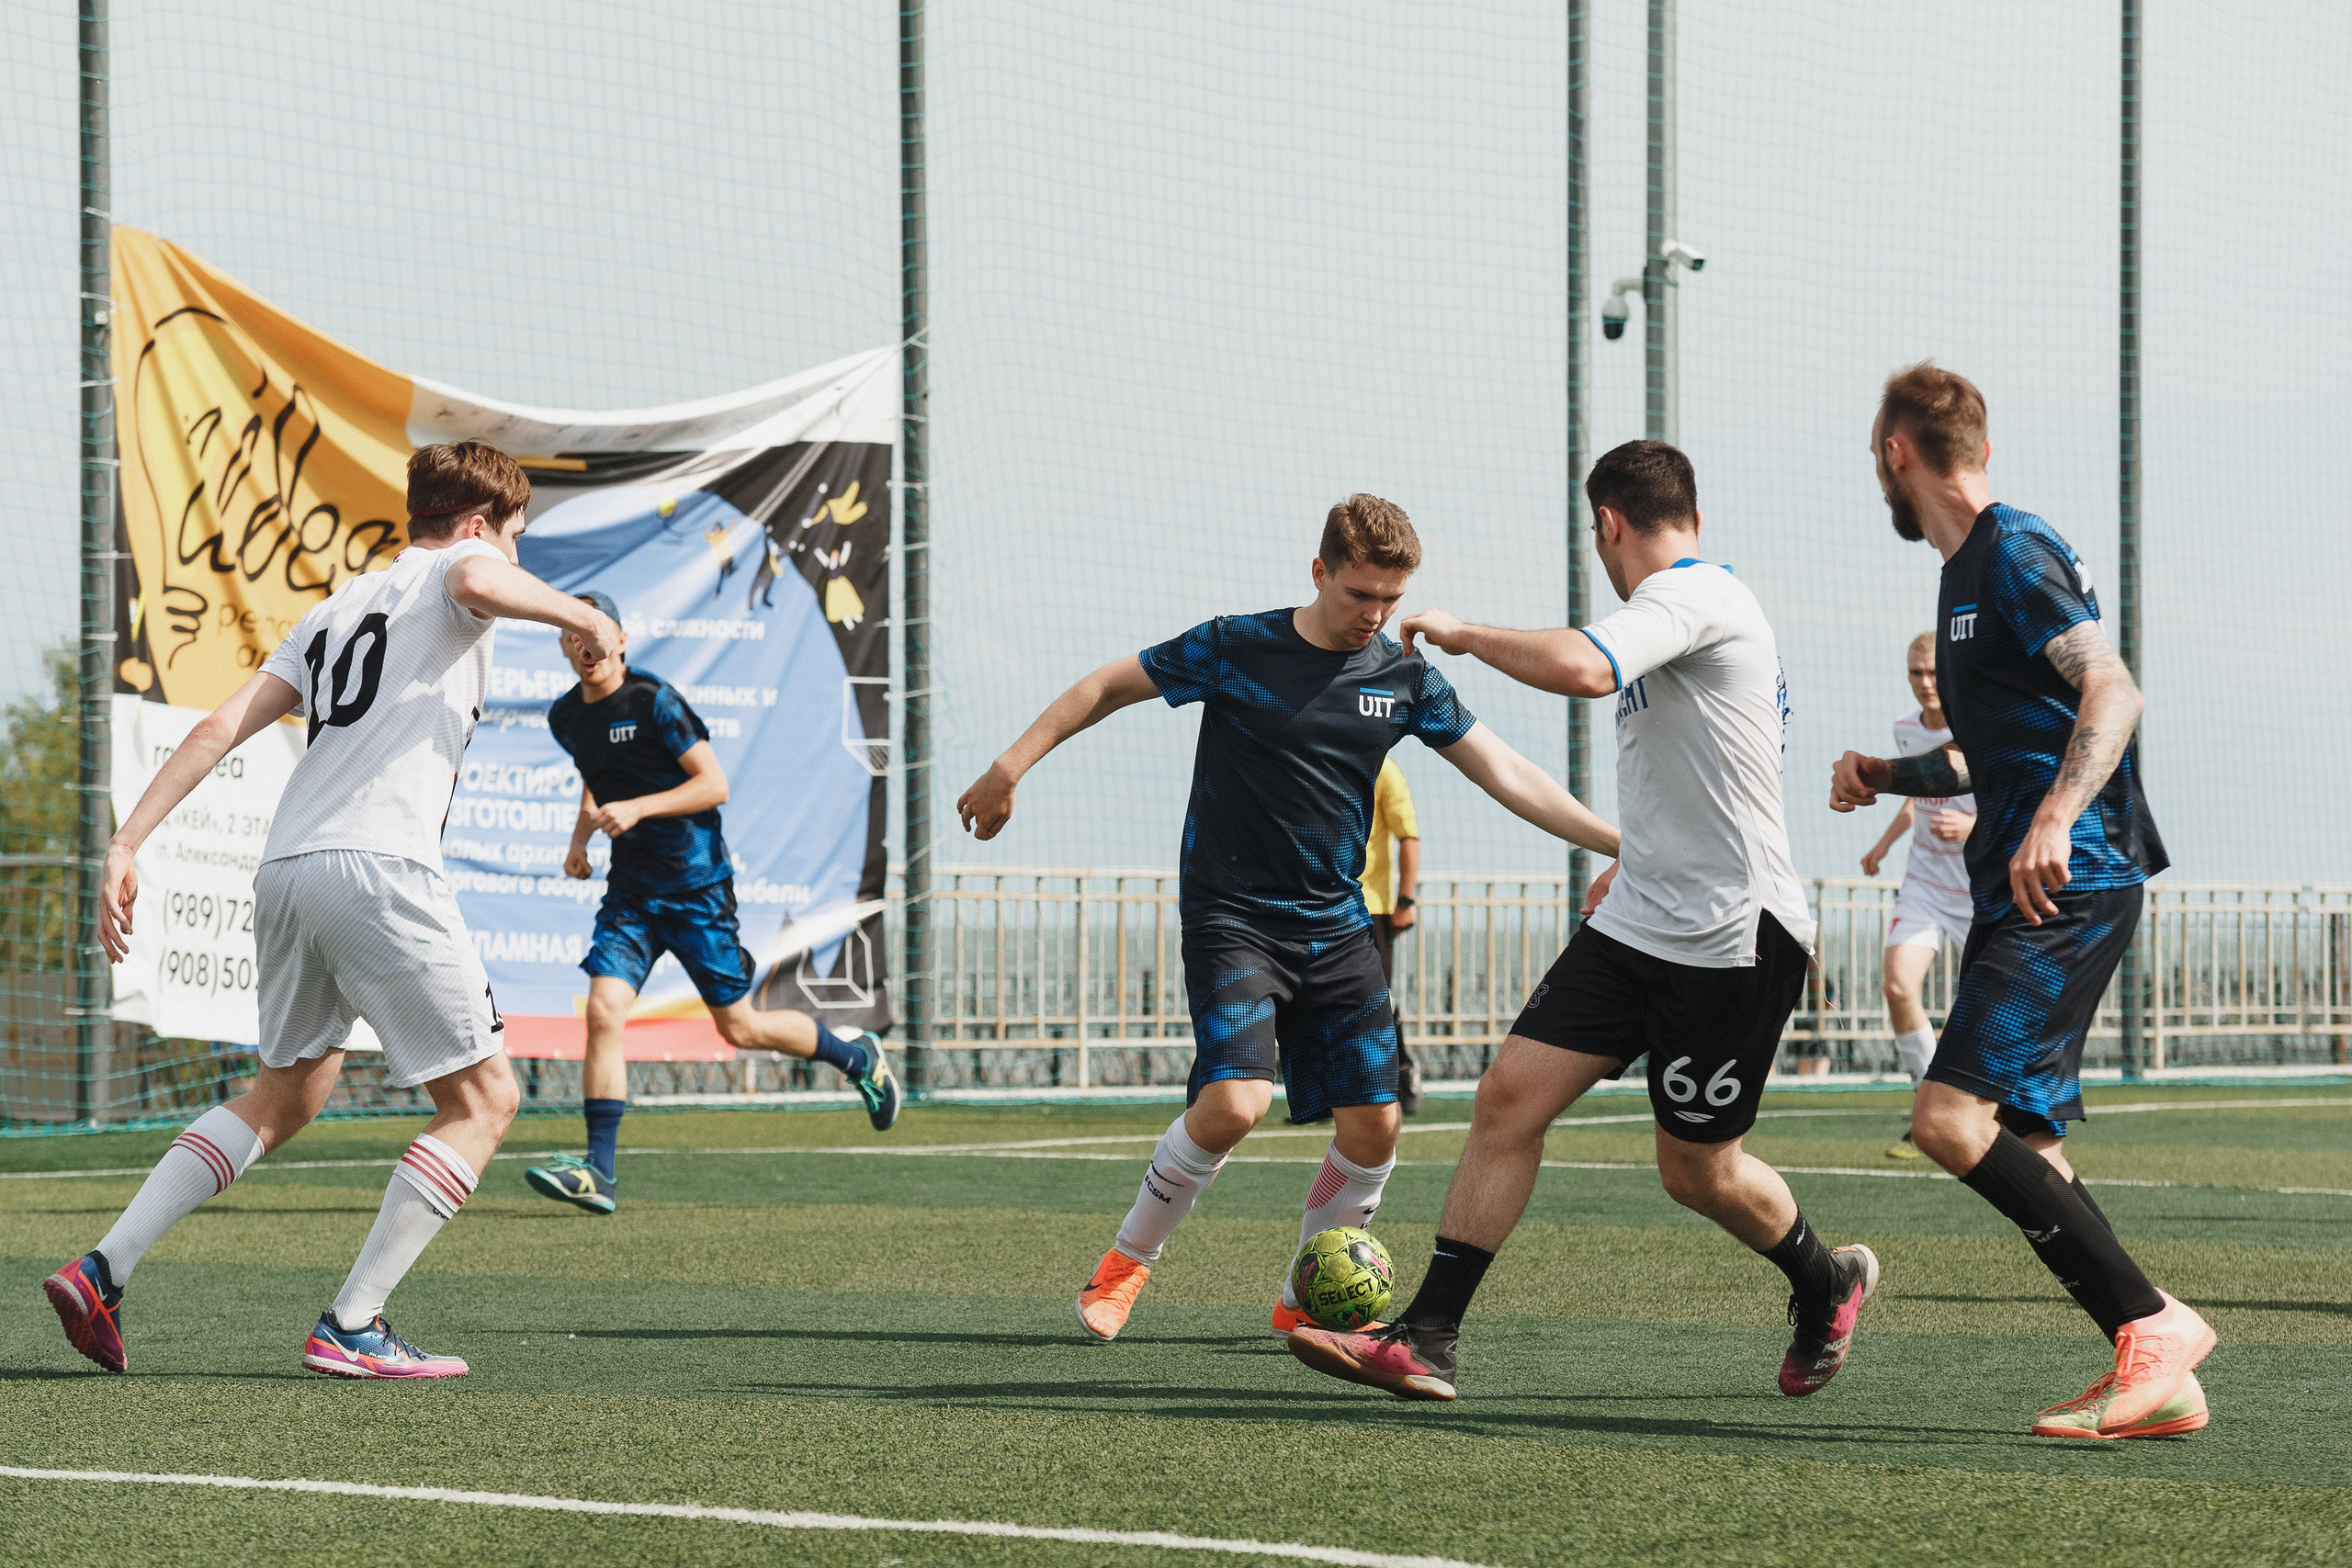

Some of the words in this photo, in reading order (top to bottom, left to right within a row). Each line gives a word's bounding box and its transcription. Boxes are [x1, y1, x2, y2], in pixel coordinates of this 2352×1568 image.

[1951, 613, 1978, 642] UIT
[304, 612, 390, 750] 10
[1359, 694, 1396, 718] UIT
[609, 725, 638, 743] UIT
[469, 929, 583, 964] ЛАМНАЯ
[158, 946, 258, 999] (908)50
[1663, 1055, 1742, 1107] 66
[1145, 1174, 1172, 1204] FCSM
[1318, 1277, 1374, 1307] SELECT
